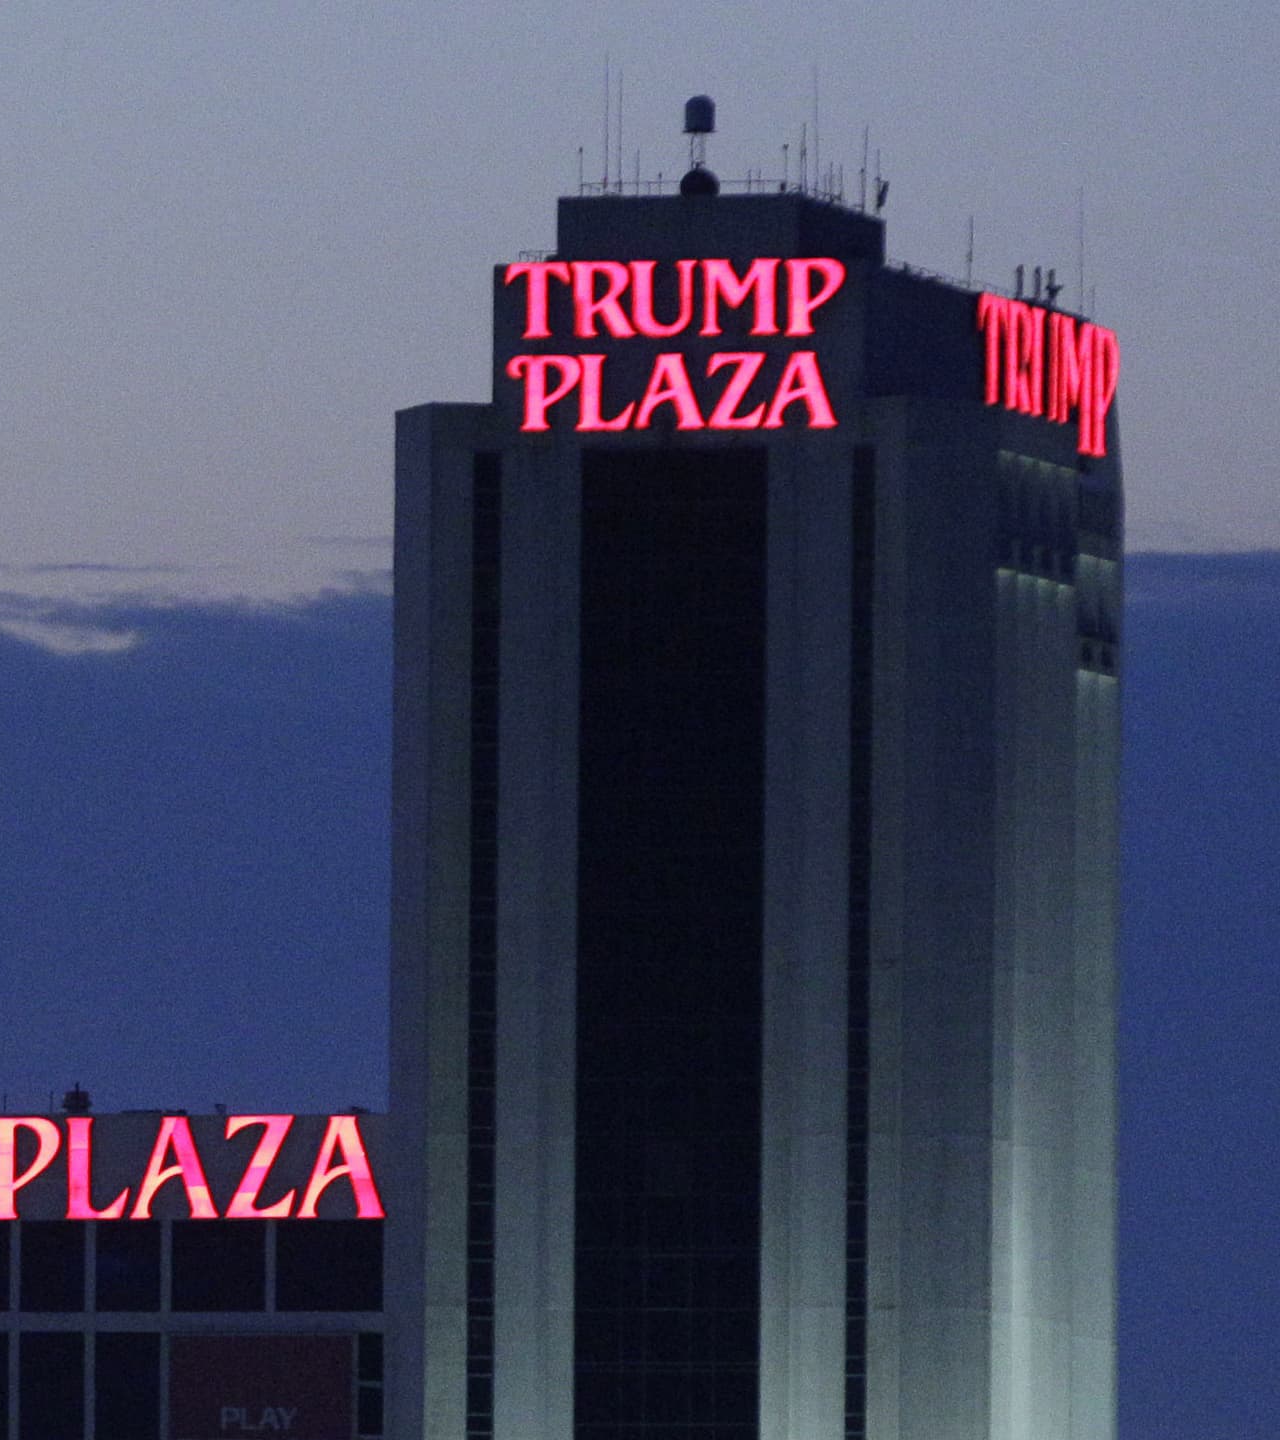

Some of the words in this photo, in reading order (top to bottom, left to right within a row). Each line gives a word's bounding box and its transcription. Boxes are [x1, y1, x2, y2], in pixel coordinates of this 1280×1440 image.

[504, 257, 846, 339] TRUMP
[506, 350, 838, 432] PLAZA
[977, 291, 1121, 458] TRUMP
[220, 1406, 298, 1431] PLAY
